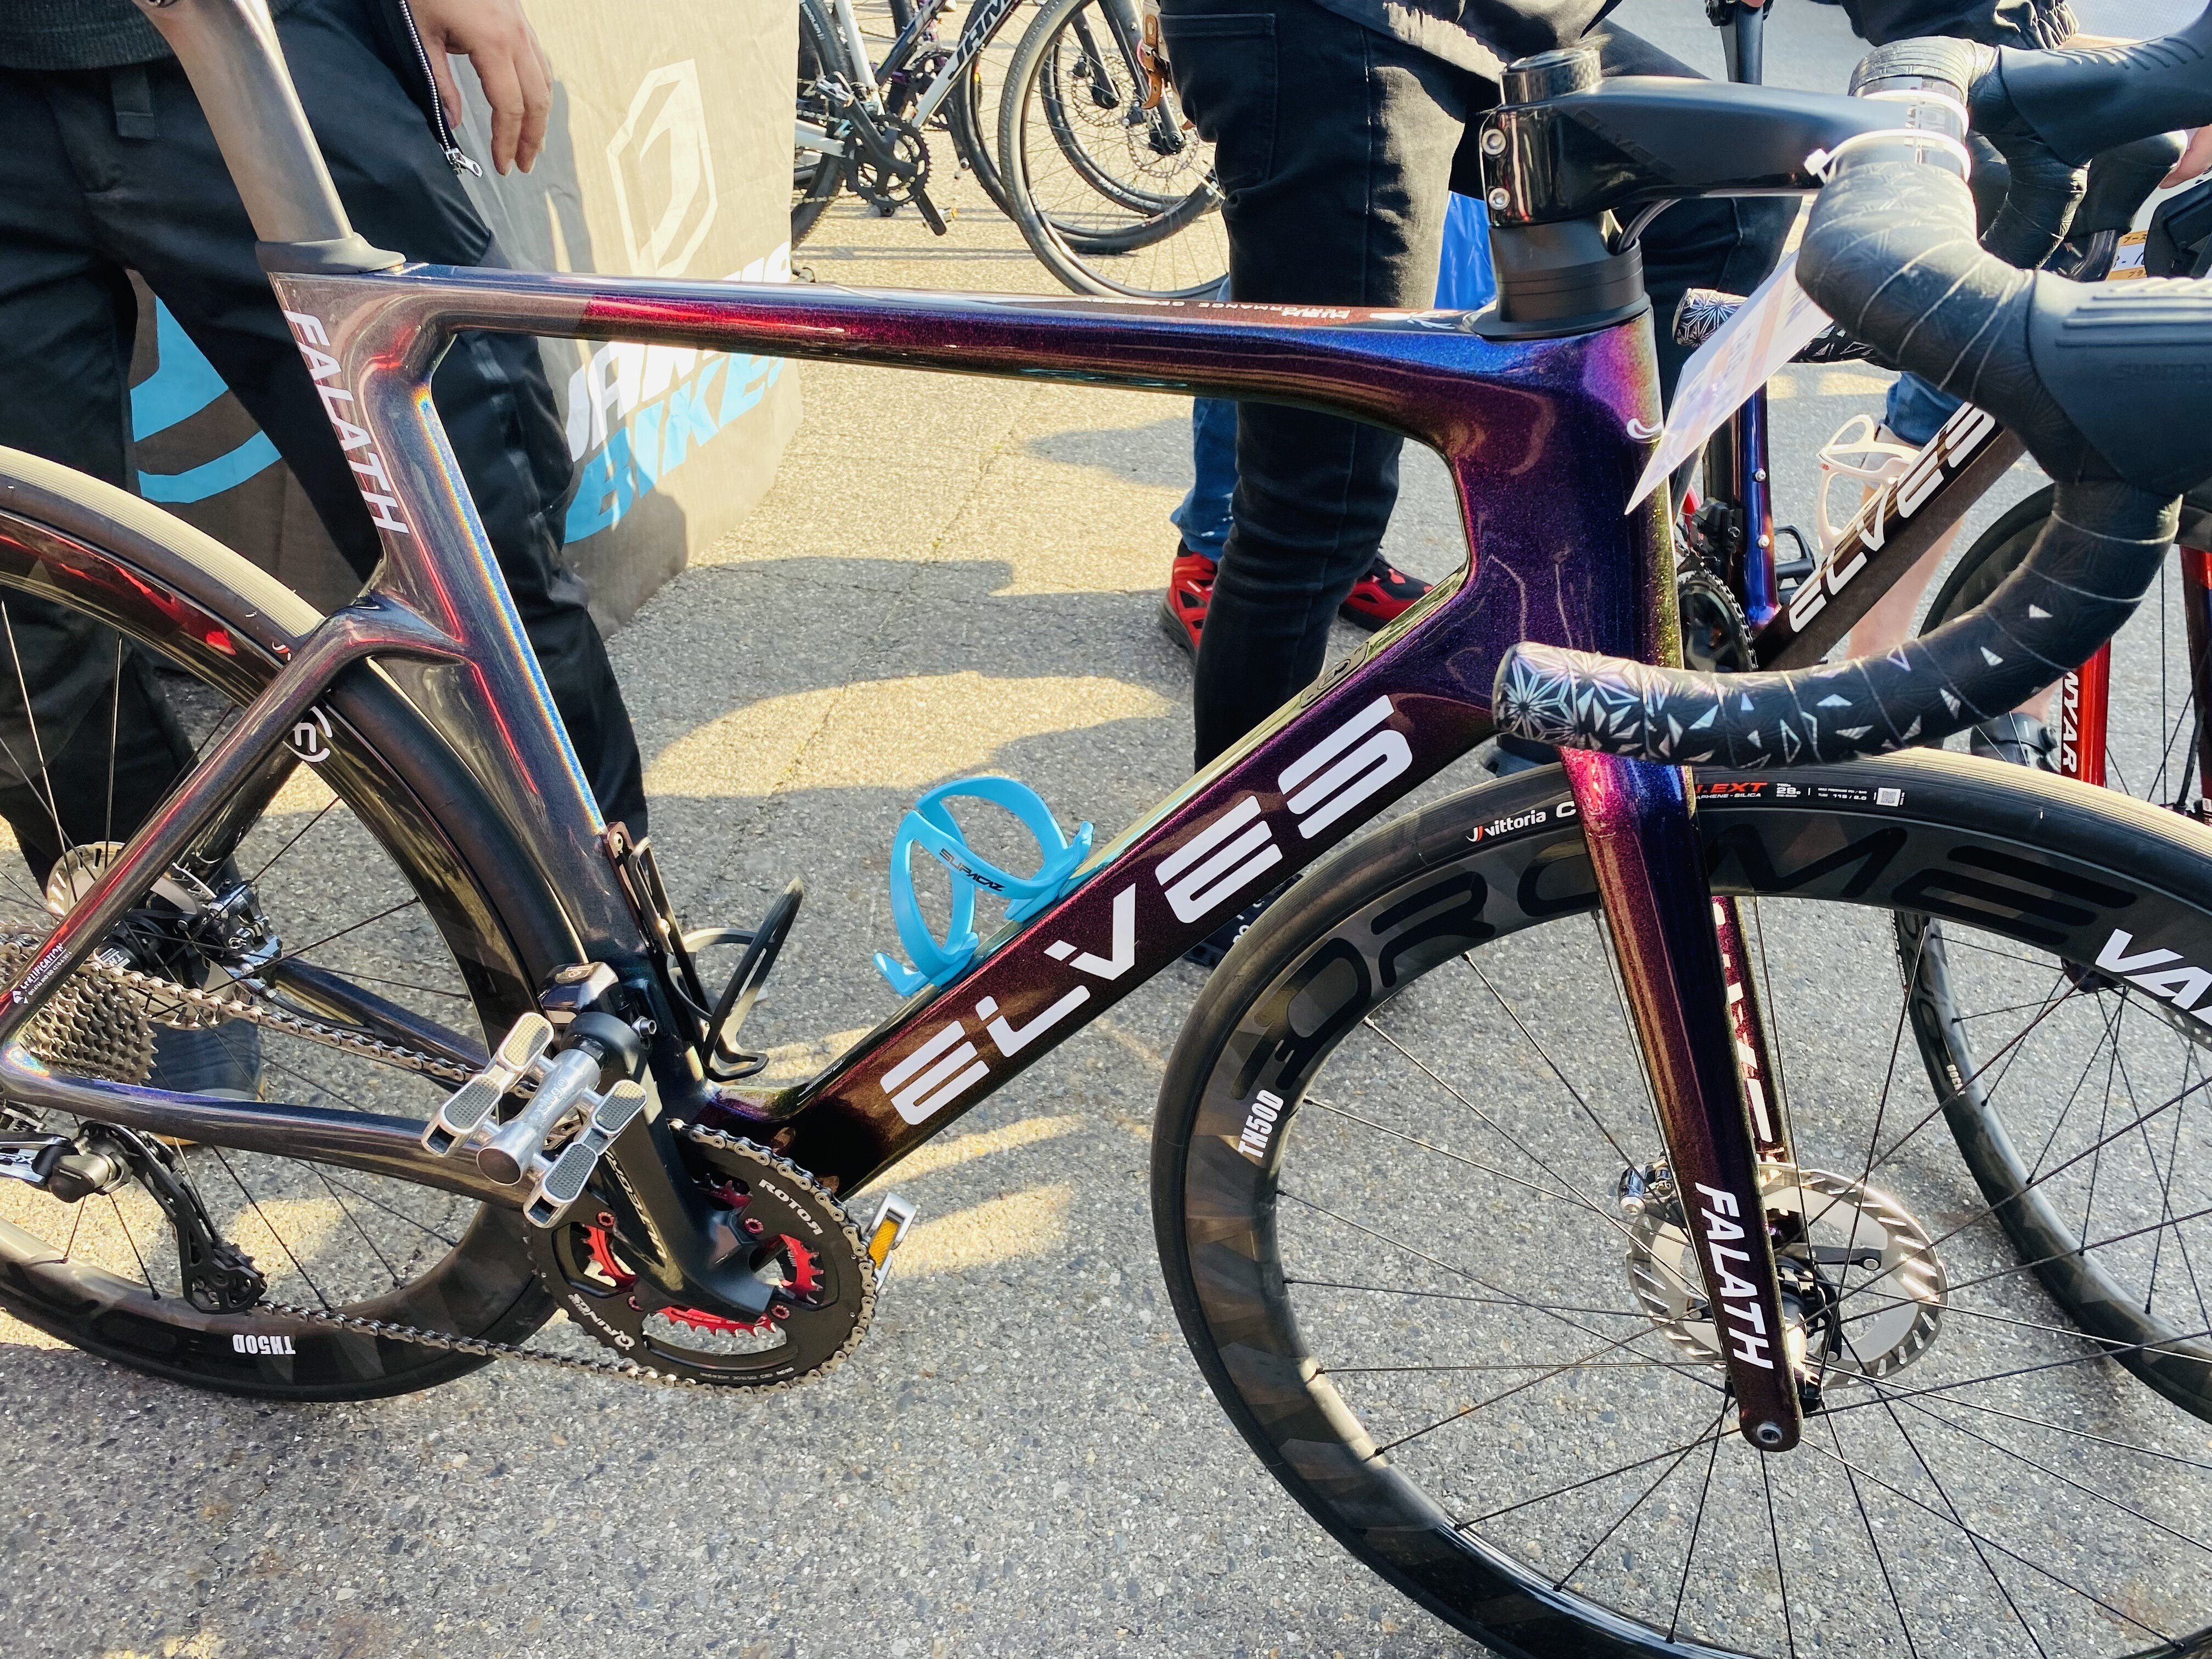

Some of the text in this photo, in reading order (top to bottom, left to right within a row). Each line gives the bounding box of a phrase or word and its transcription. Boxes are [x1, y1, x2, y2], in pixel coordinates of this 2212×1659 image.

[284, 309, 410, 533] FALATH
[1789, 401, 1996, 633] ELVES
[1485, 809, 1547, 836] vittoria
[939, 848, 1006, 892] SUPACAZ
[880, 695, 1413, 1125] ELVES
[1237, 1089, 1284, 1159] TH50D
[758, 1178, 824, 1235] ROTOR
[1695, 1182, 1774, 1369] FALATH
[233, 1334, 296, 1355] TH50D
